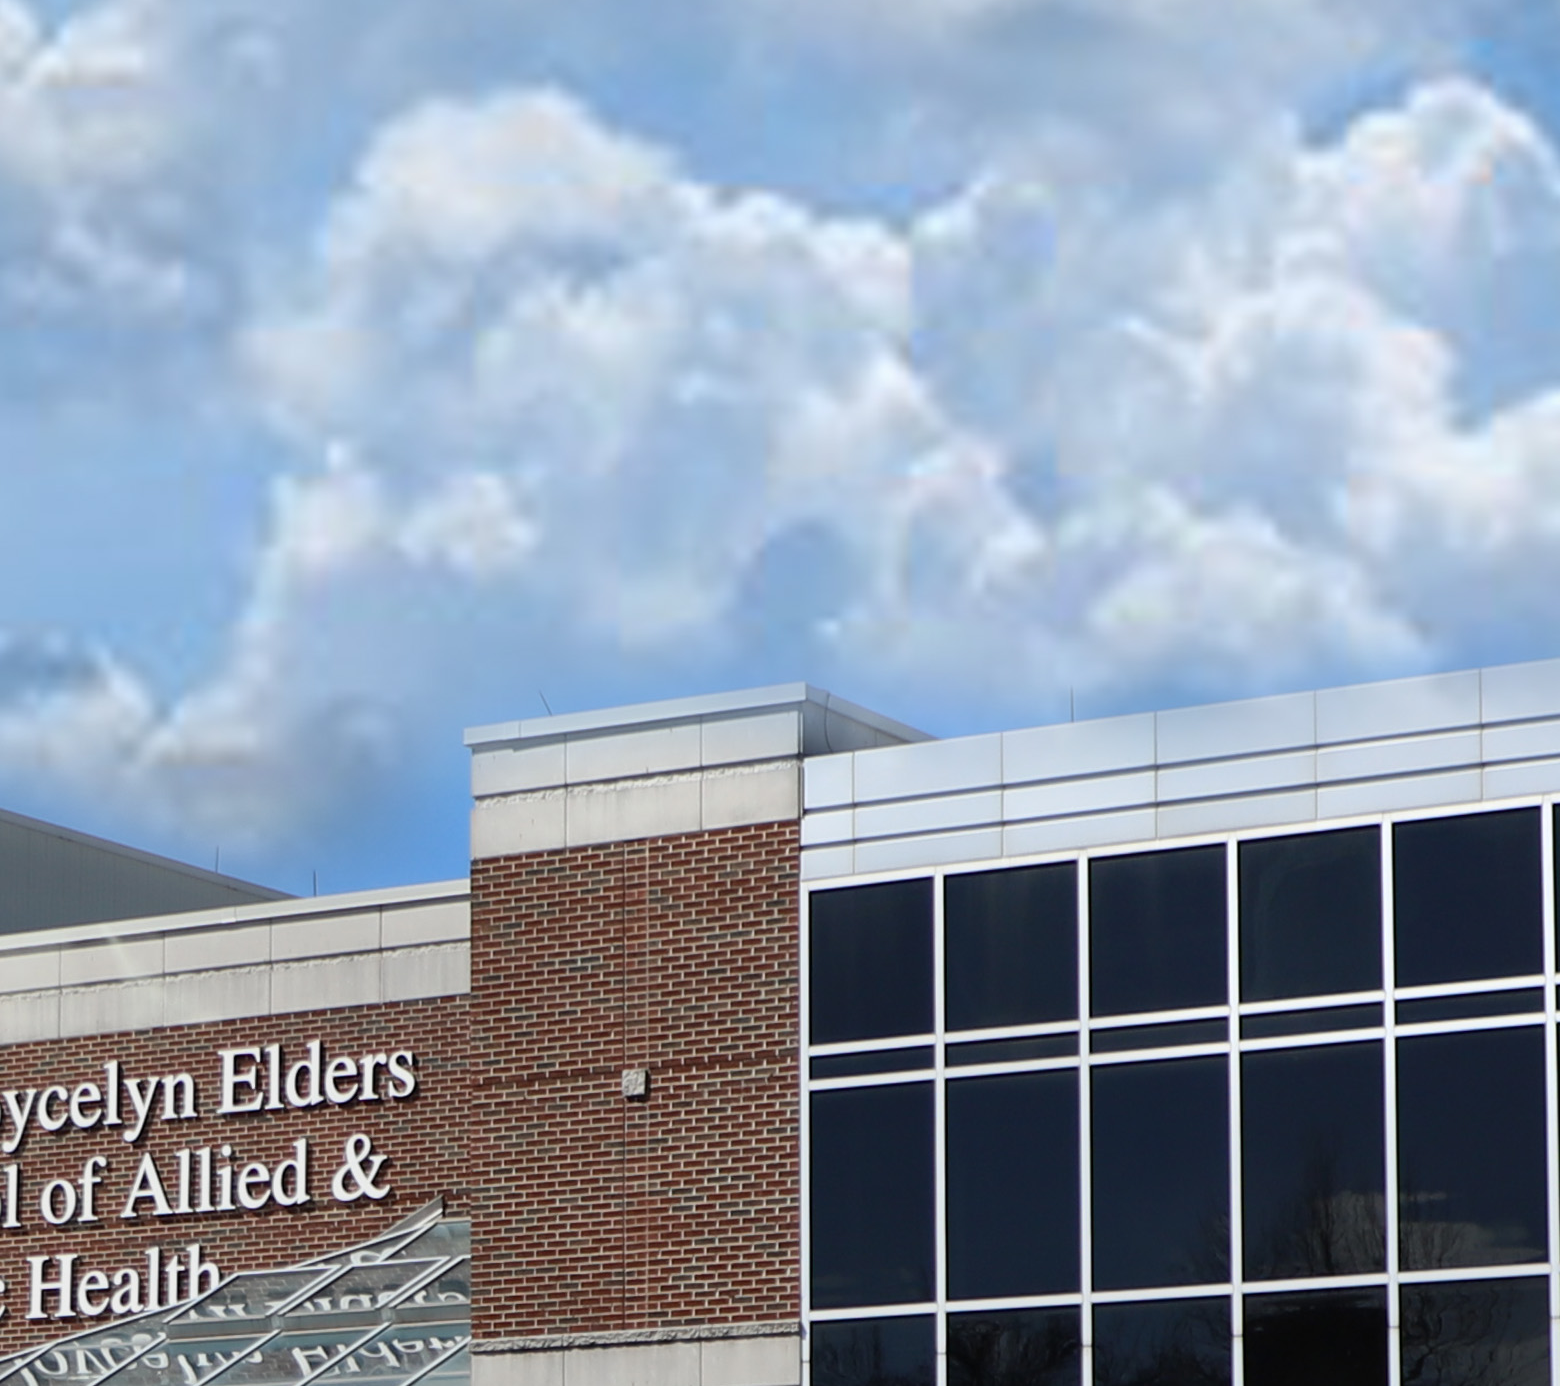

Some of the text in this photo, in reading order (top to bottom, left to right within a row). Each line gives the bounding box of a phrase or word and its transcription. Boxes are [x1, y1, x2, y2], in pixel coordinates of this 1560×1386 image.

[216, 1039, 418, 1117] Elders
[40, 1155, 108, 1226] of
[120, 1138, 311, 1220] Allied
[330, 1132, 392, 1201] &
[25, 1243, 222, 1321] Health
